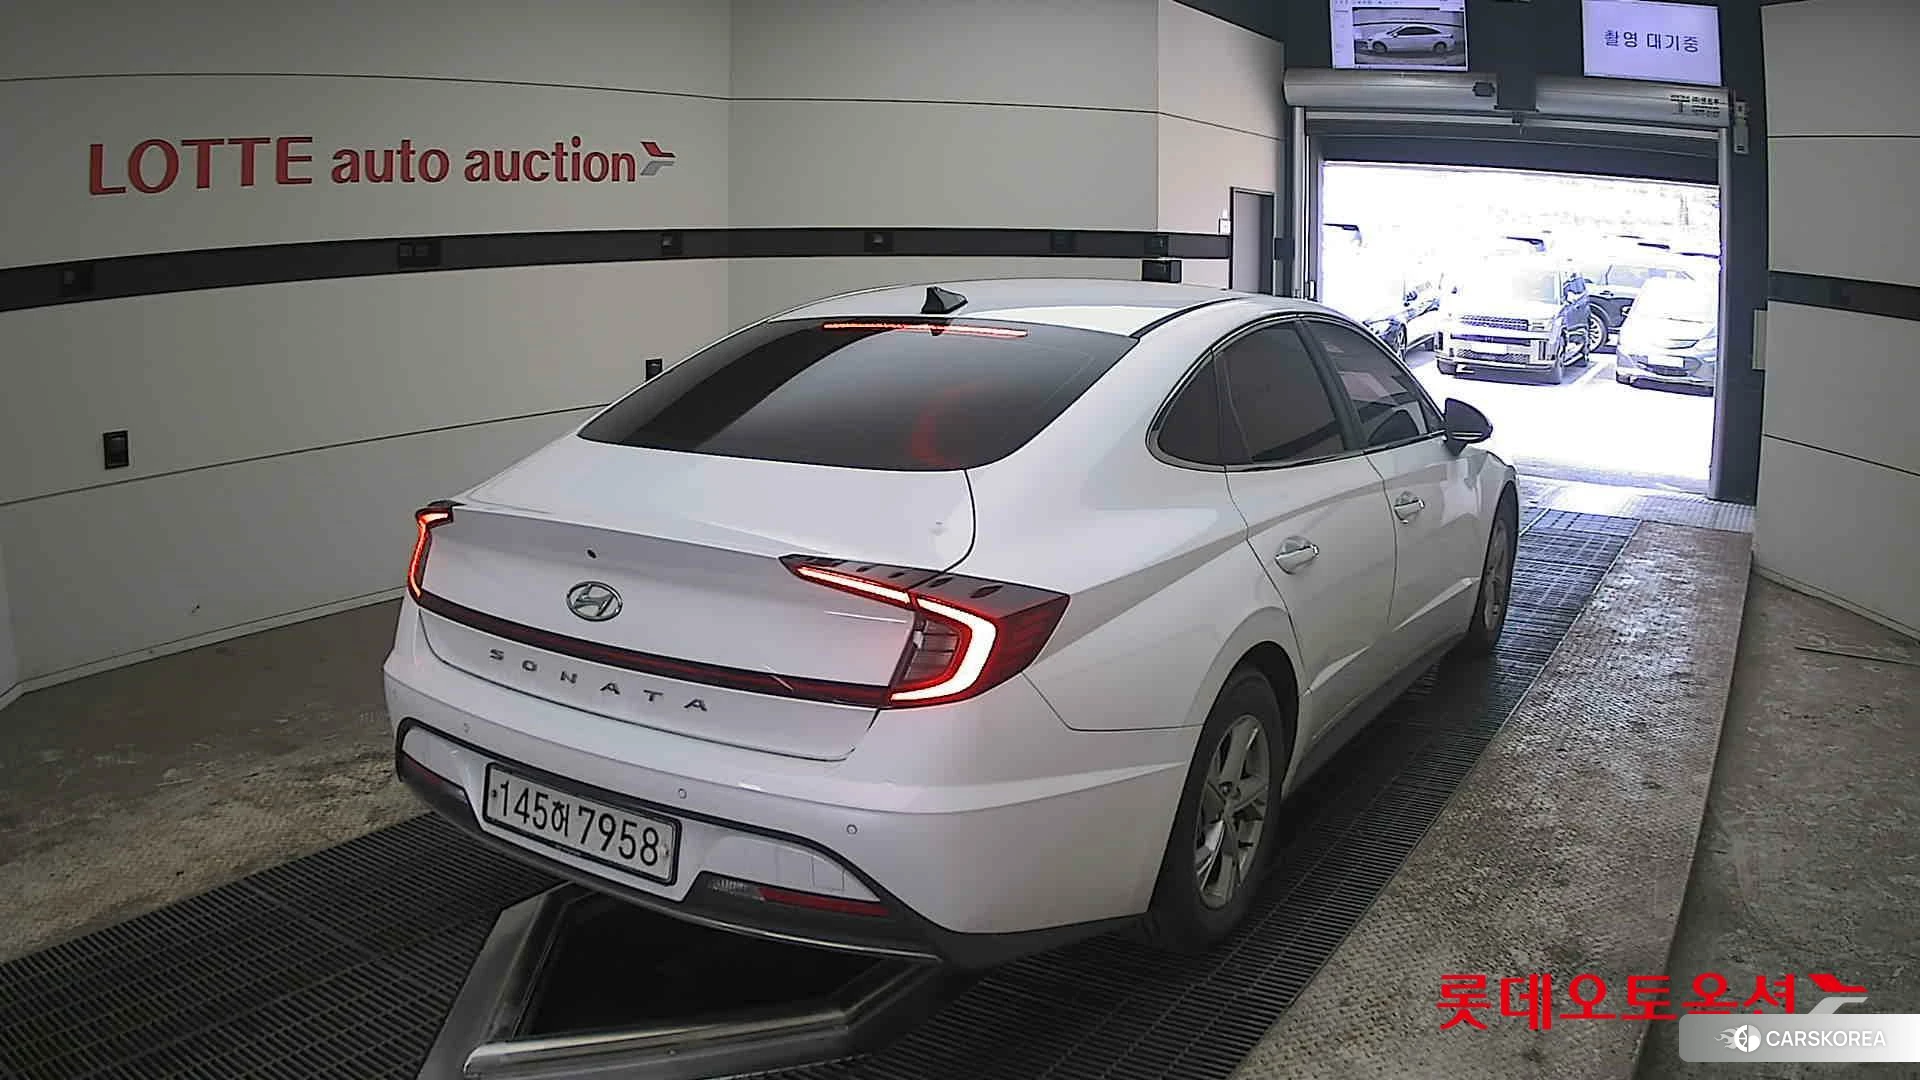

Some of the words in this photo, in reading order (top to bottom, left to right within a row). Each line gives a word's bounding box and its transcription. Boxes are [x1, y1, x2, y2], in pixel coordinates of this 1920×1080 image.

[1646, 32, 1699, 53] 대기중
[89, 136, 313, 195] LOTTE
[331, 139, 450, 183] auto
[464, 136, 638, 183] auction
[488, 647, 707, 712] SONATA
